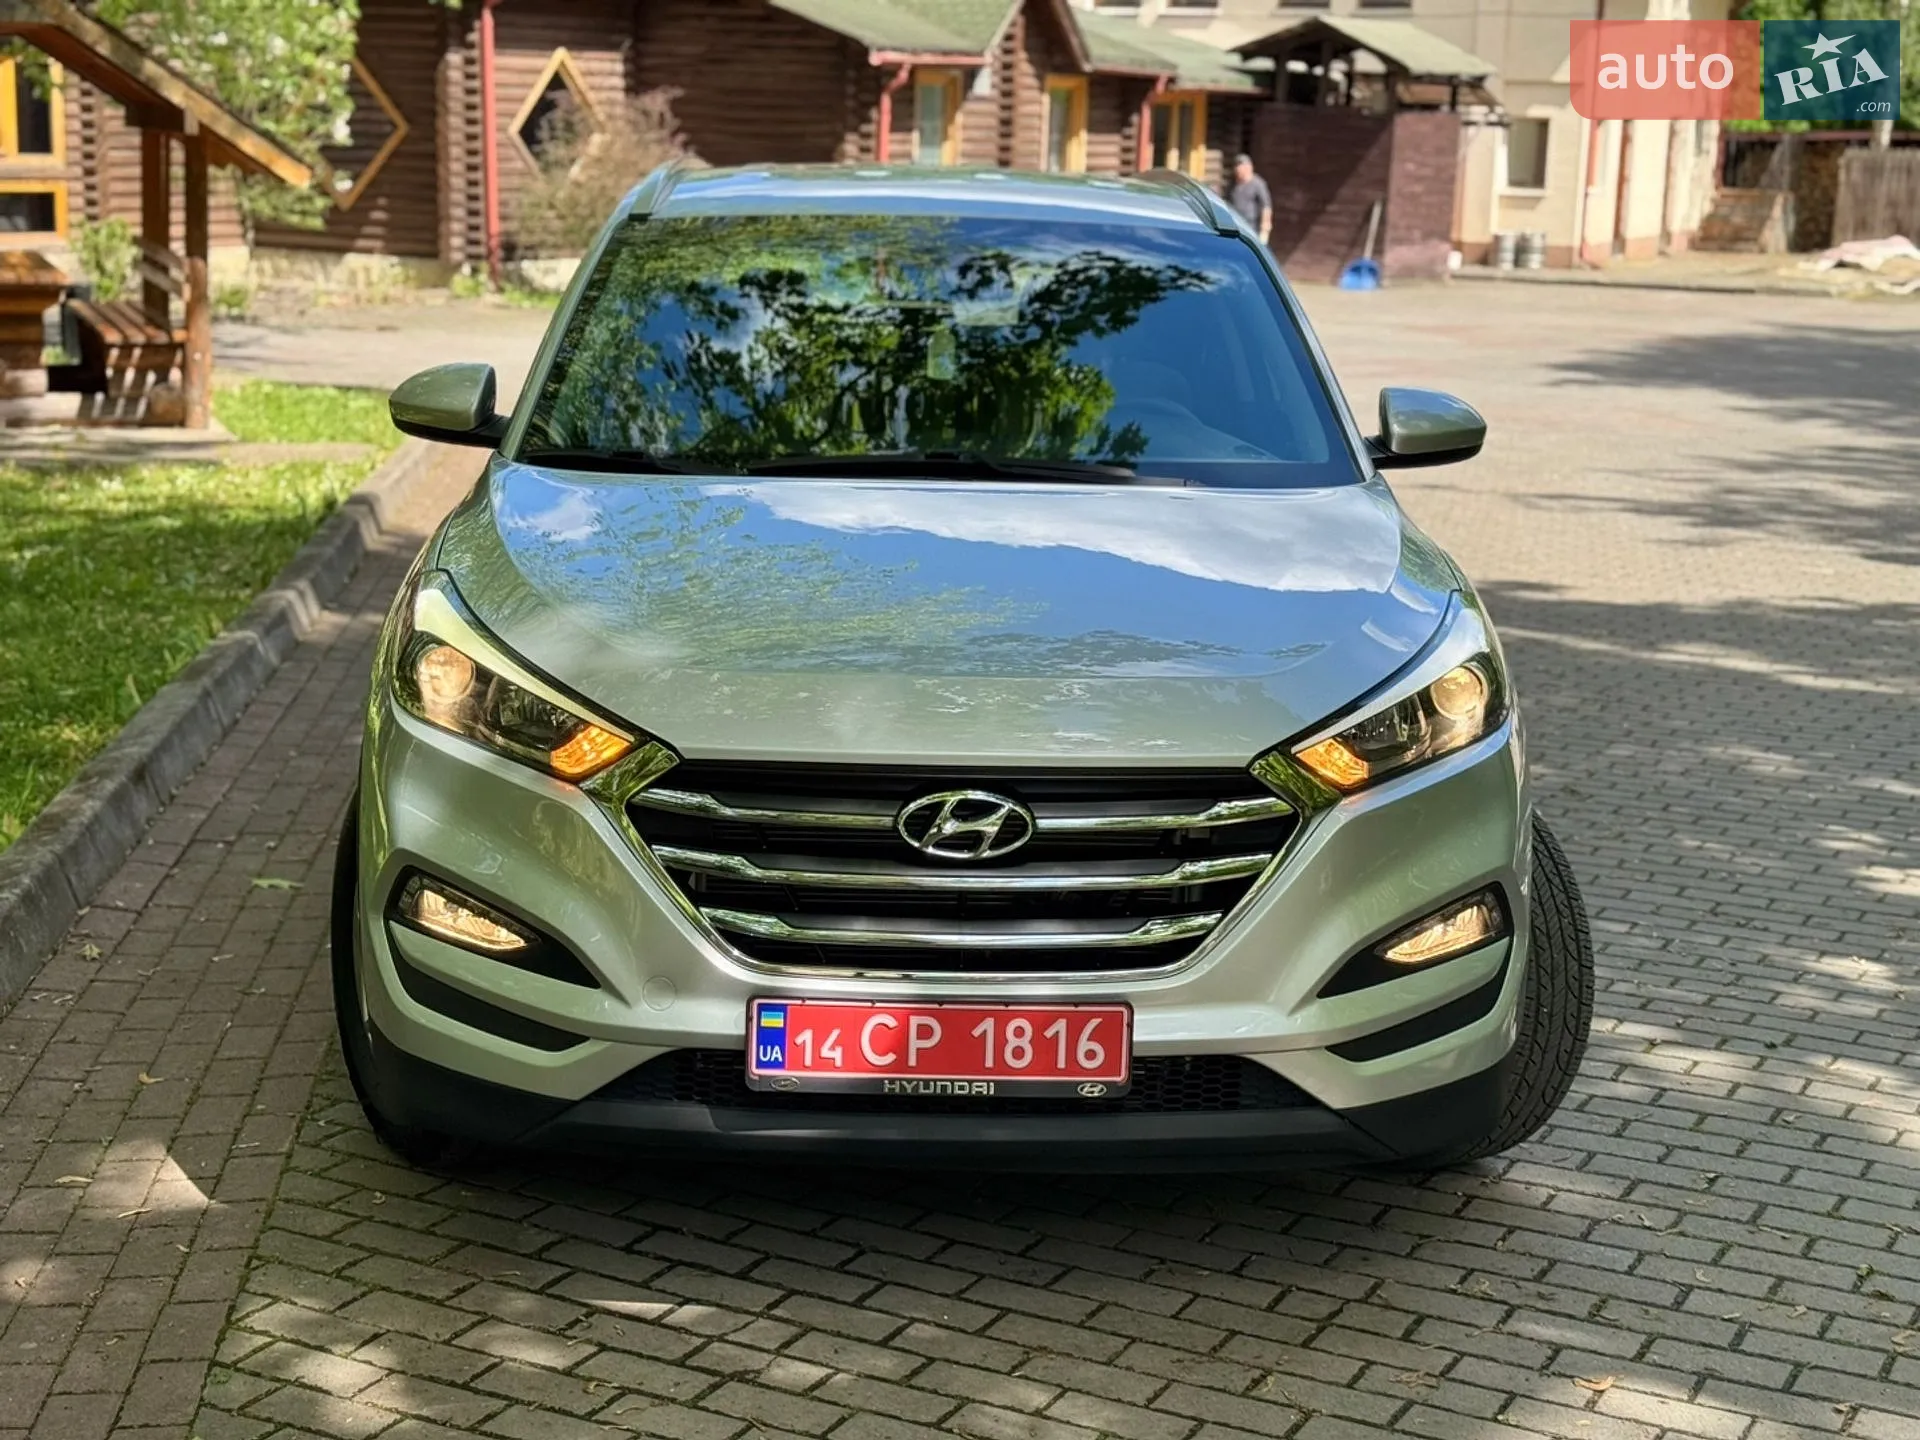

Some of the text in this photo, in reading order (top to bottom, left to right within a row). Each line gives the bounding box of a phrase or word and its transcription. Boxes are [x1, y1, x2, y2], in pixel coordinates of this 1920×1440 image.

[794, 1013, 1106, 1070] 14 CP 1816
[759, 1045, 783, 1062] UA
[883, 1079, 995, 1096] HYUNDAI
